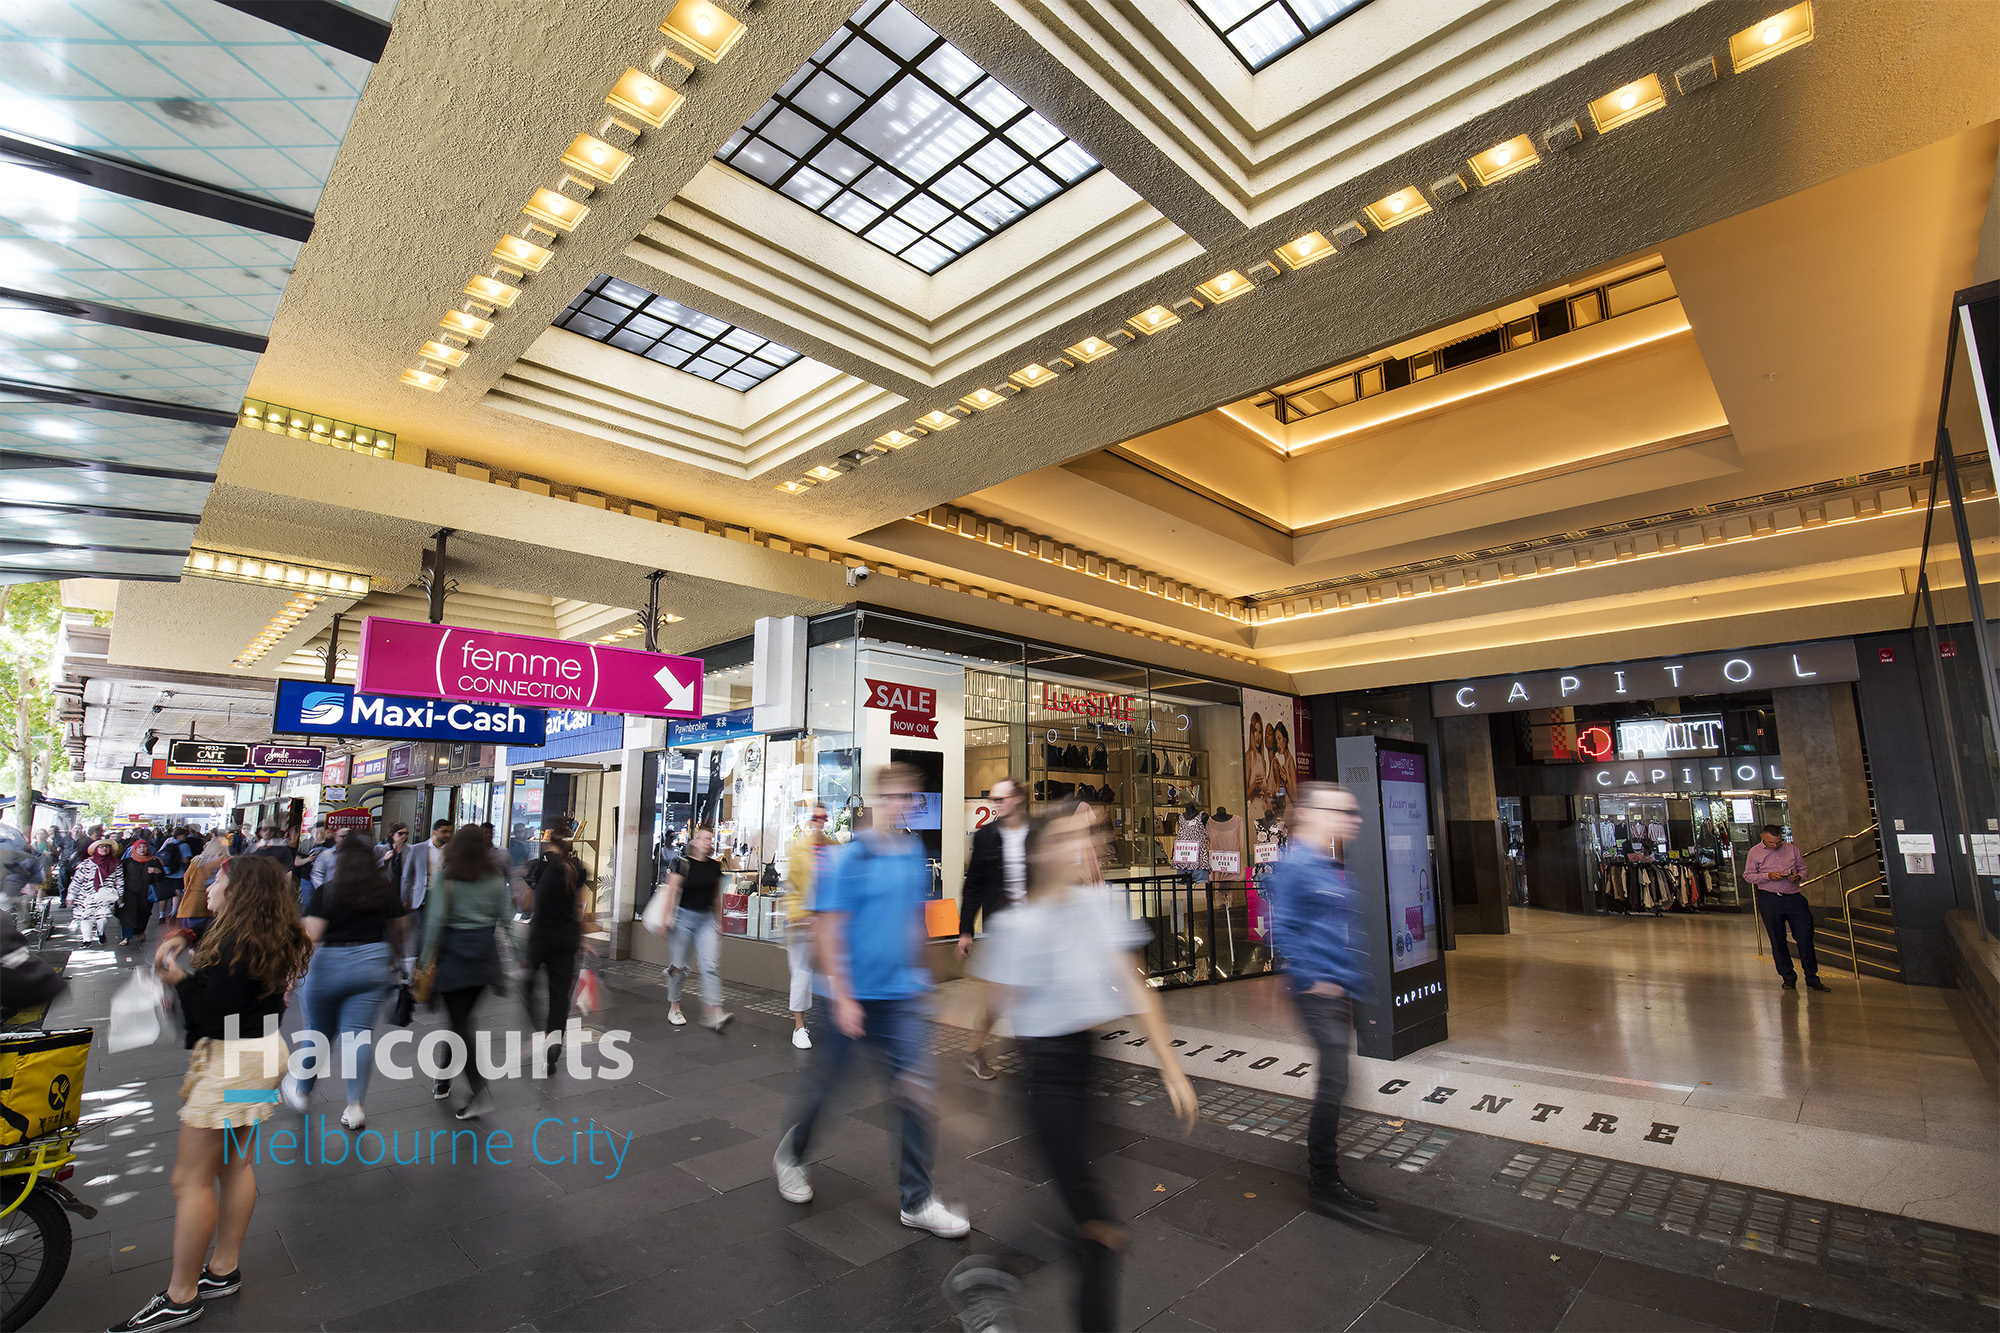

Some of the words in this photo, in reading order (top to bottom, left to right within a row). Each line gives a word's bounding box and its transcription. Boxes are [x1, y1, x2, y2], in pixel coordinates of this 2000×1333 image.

[461, 639, 582, 681] femme
[457, 675, 581, 701] CONNECTION
[1456, 653, 1817, 708] CAPITOL
[876, 685, 931, 714] SALE
[1045, 684, 1136, 722] LuxeSTYLE
[351, 695, 526, 734] Maxi-Cash
[546, 709, 592, 735] axi-Cash
[675, 720, 709, 735] Pawnbroker
[893, 720, 914, 732] NOW
[916, 723, 930, 733] ON
[1617, 720, 1723, 753] RMIT
[1597, 764, 1785, 786] CAPITOL
[328, 815, 370, 825] CHEMIST
[1395, 981, 1442, 1007] CAPITOL
[1377, 1078, 1681, 1146] CENTRE
